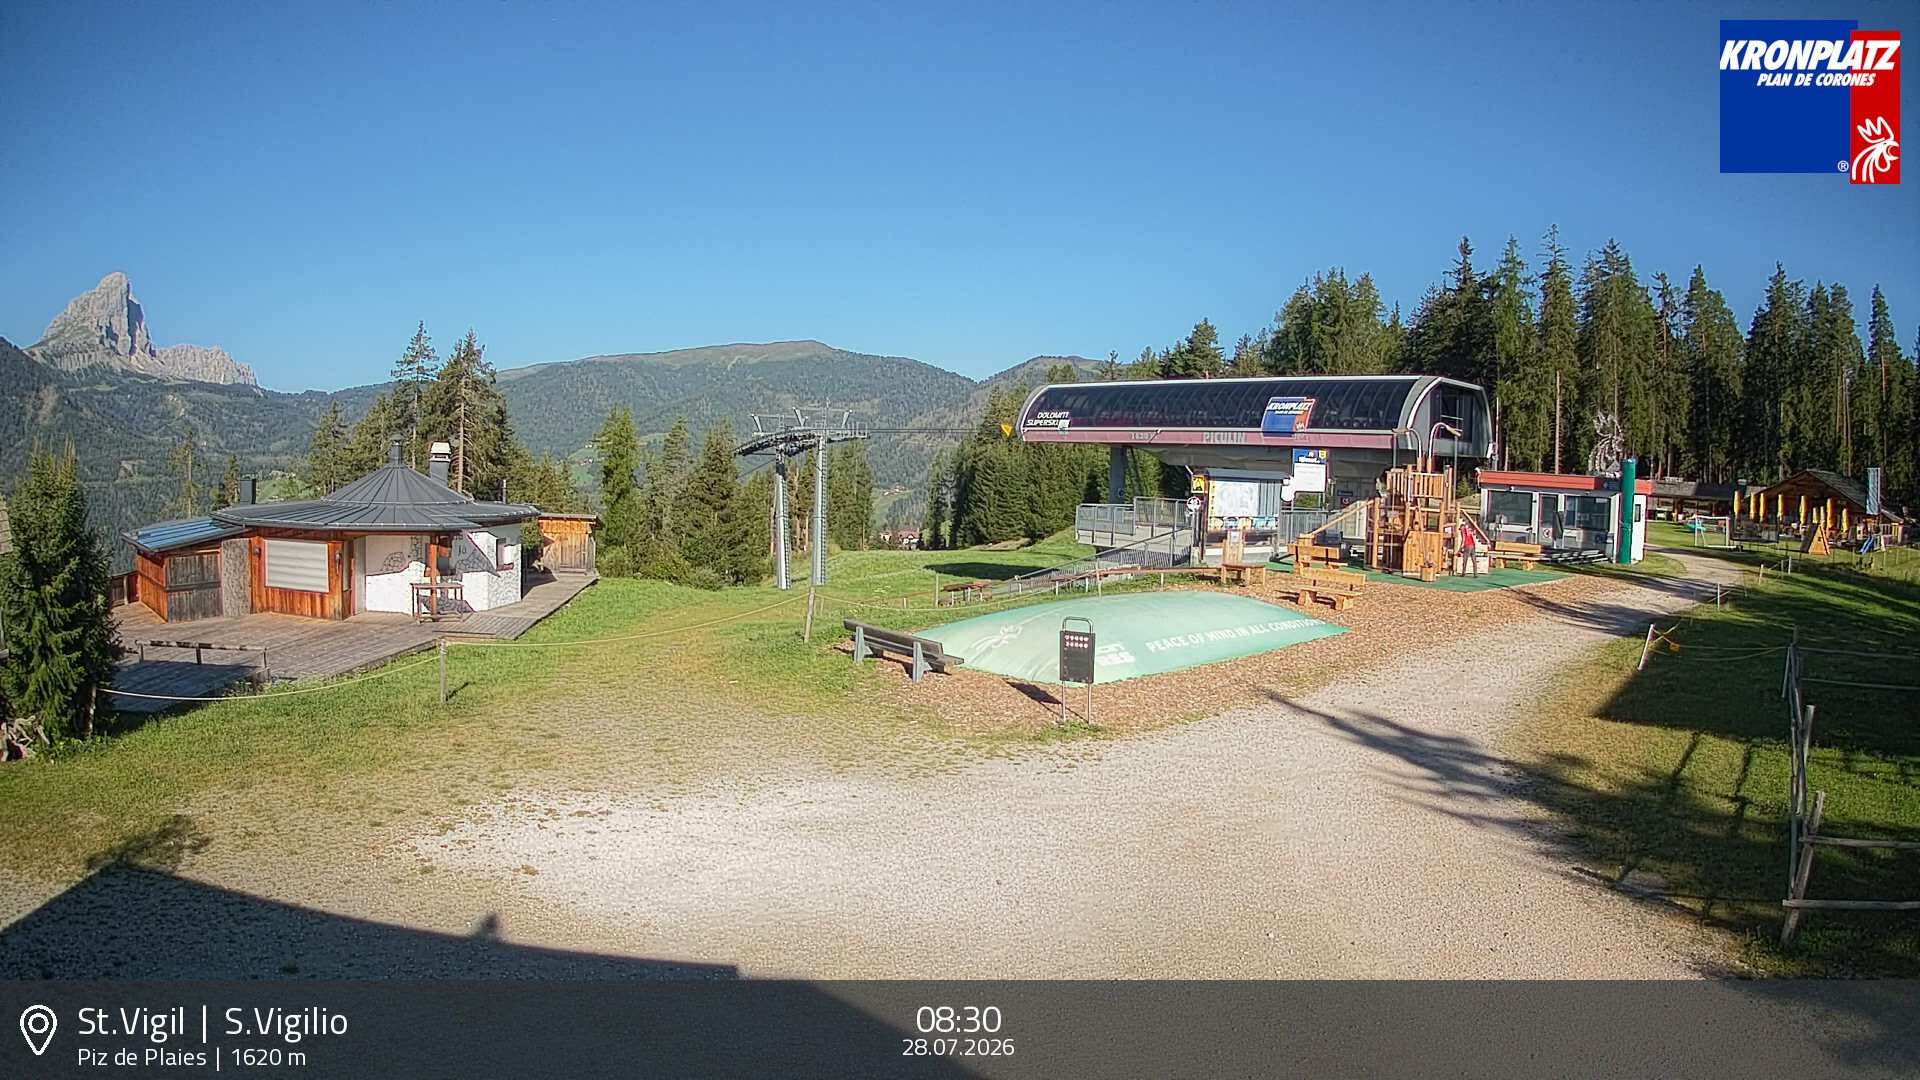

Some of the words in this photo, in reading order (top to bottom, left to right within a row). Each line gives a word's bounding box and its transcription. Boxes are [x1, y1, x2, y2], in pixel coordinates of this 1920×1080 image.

[1037, 411, 1070, 419] DOLOMITI
[1202, 431, 1246, 444] PICULIN
[1145, 635, 1190, 652] PEACE
[1187, 632, 1206, 646] OF
[1205, 628, 1237, 642] MIND
[1235, 626, 1251, 638] IN
[1248, 623, 1270, 635] ALL
